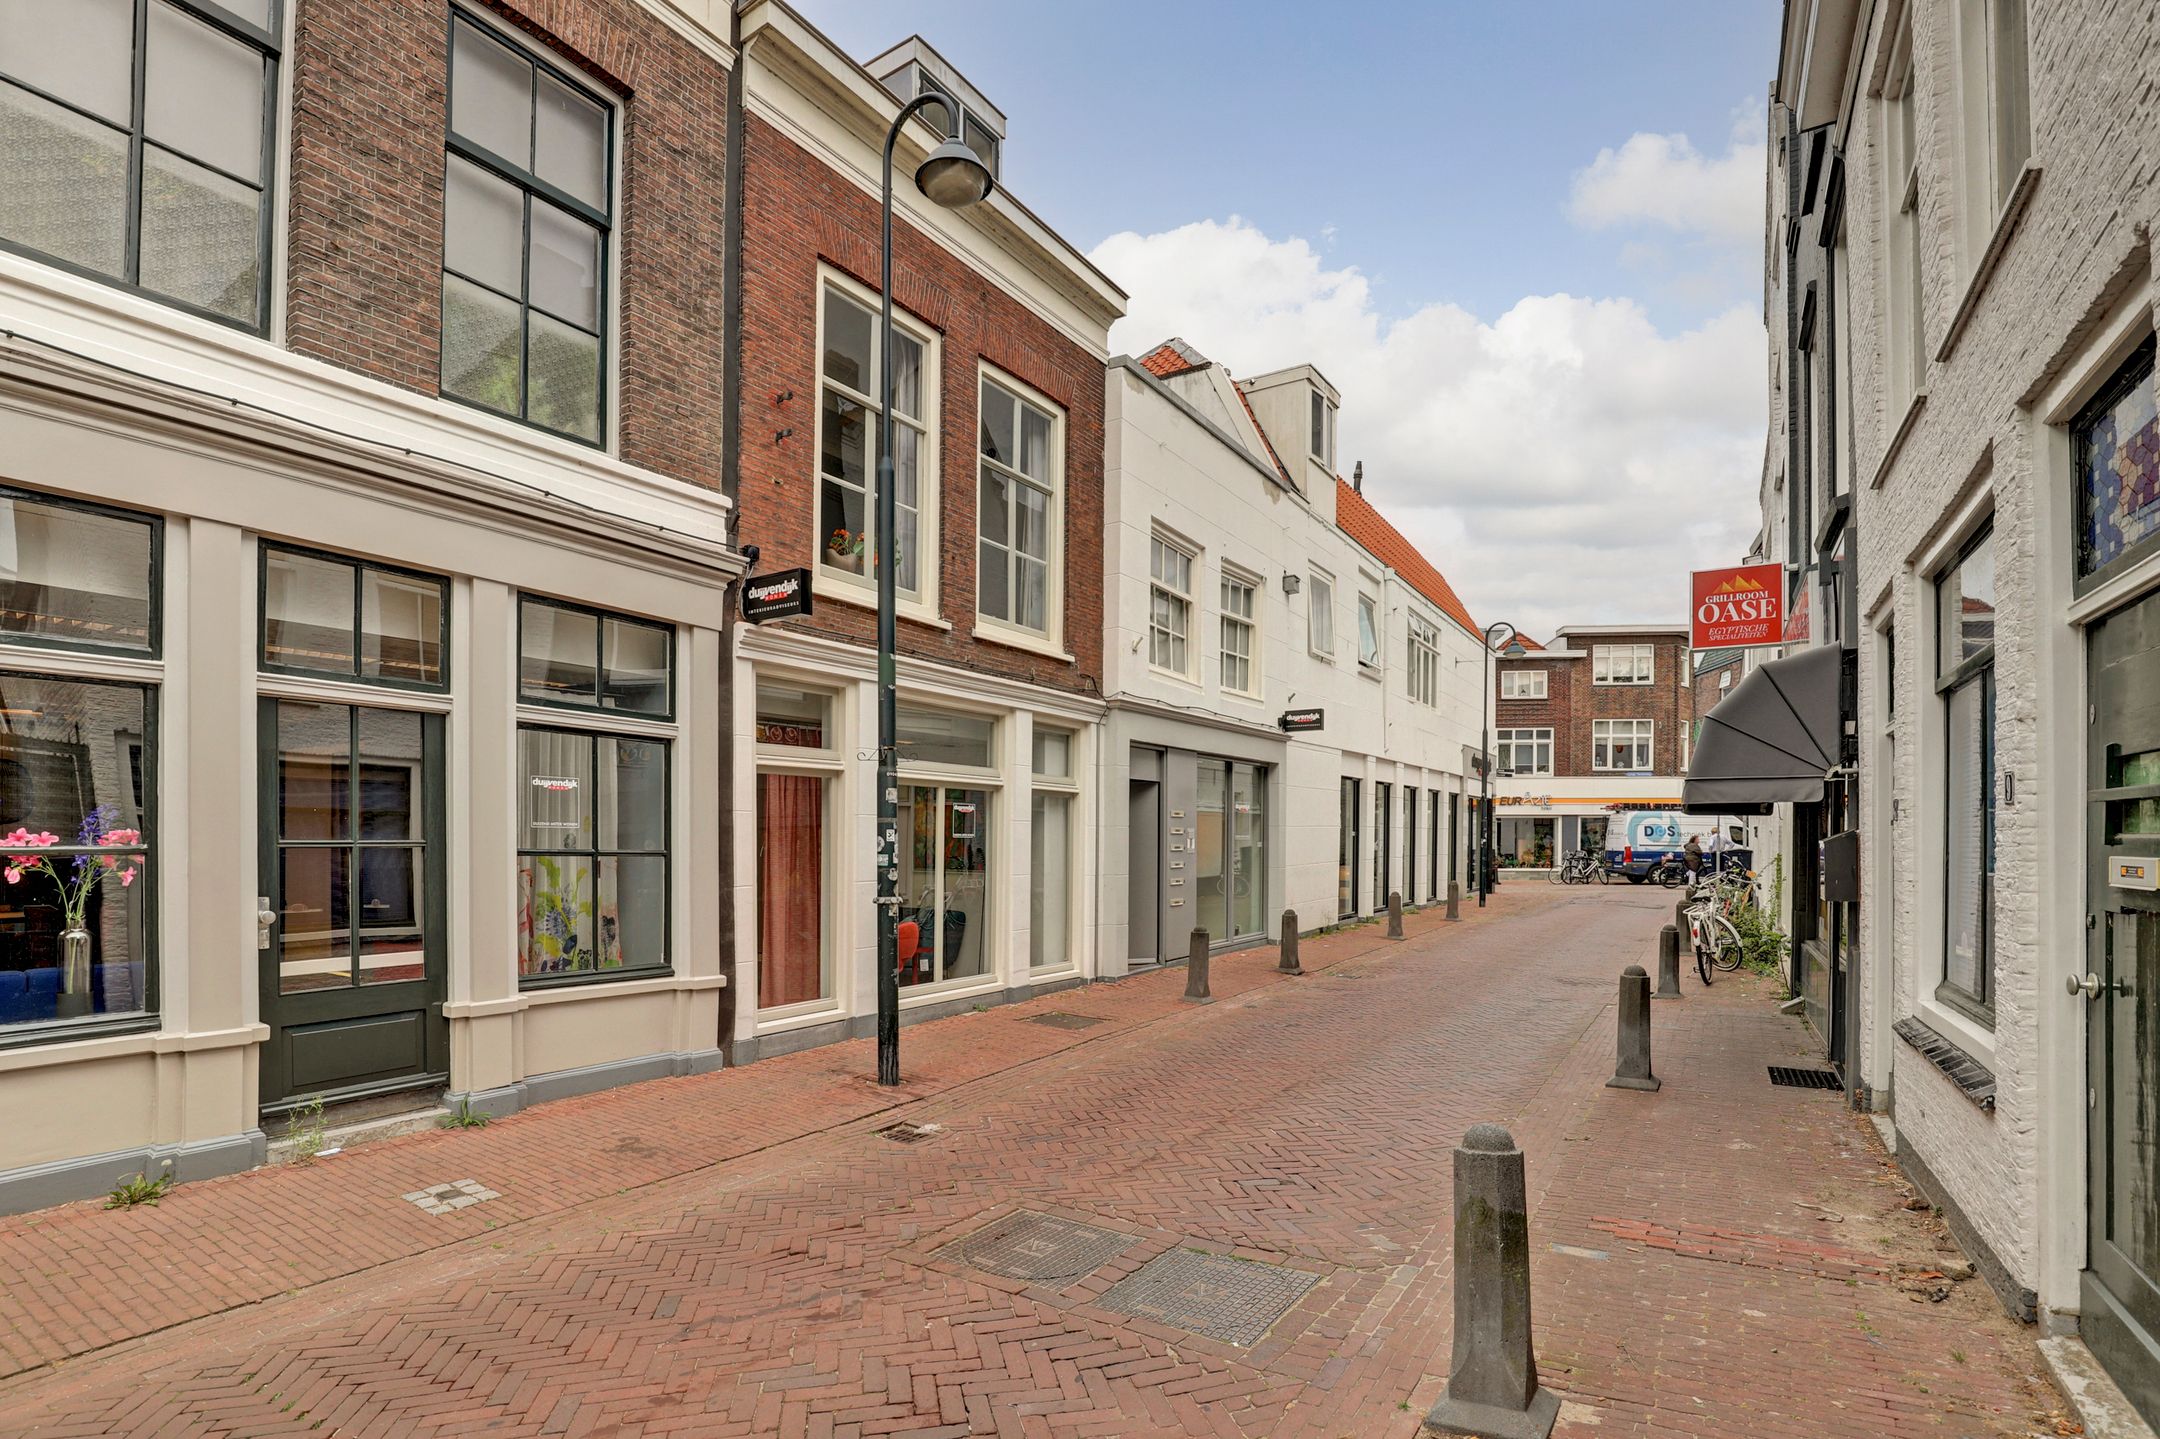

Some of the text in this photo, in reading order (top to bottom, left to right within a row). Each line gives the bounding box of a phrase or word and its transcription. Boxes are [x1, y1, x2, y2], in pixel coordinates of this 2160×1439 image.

[1705, 591, 1769, 604] GRILLROOM
[1698, 598, 1776, 624] OASE
[1708, 623, 1770, 635] EGYPTISCHE
[1708, 631, 1769, 641] SPECIALITEITEN
[1644, 825, 1676, 837] DOS
